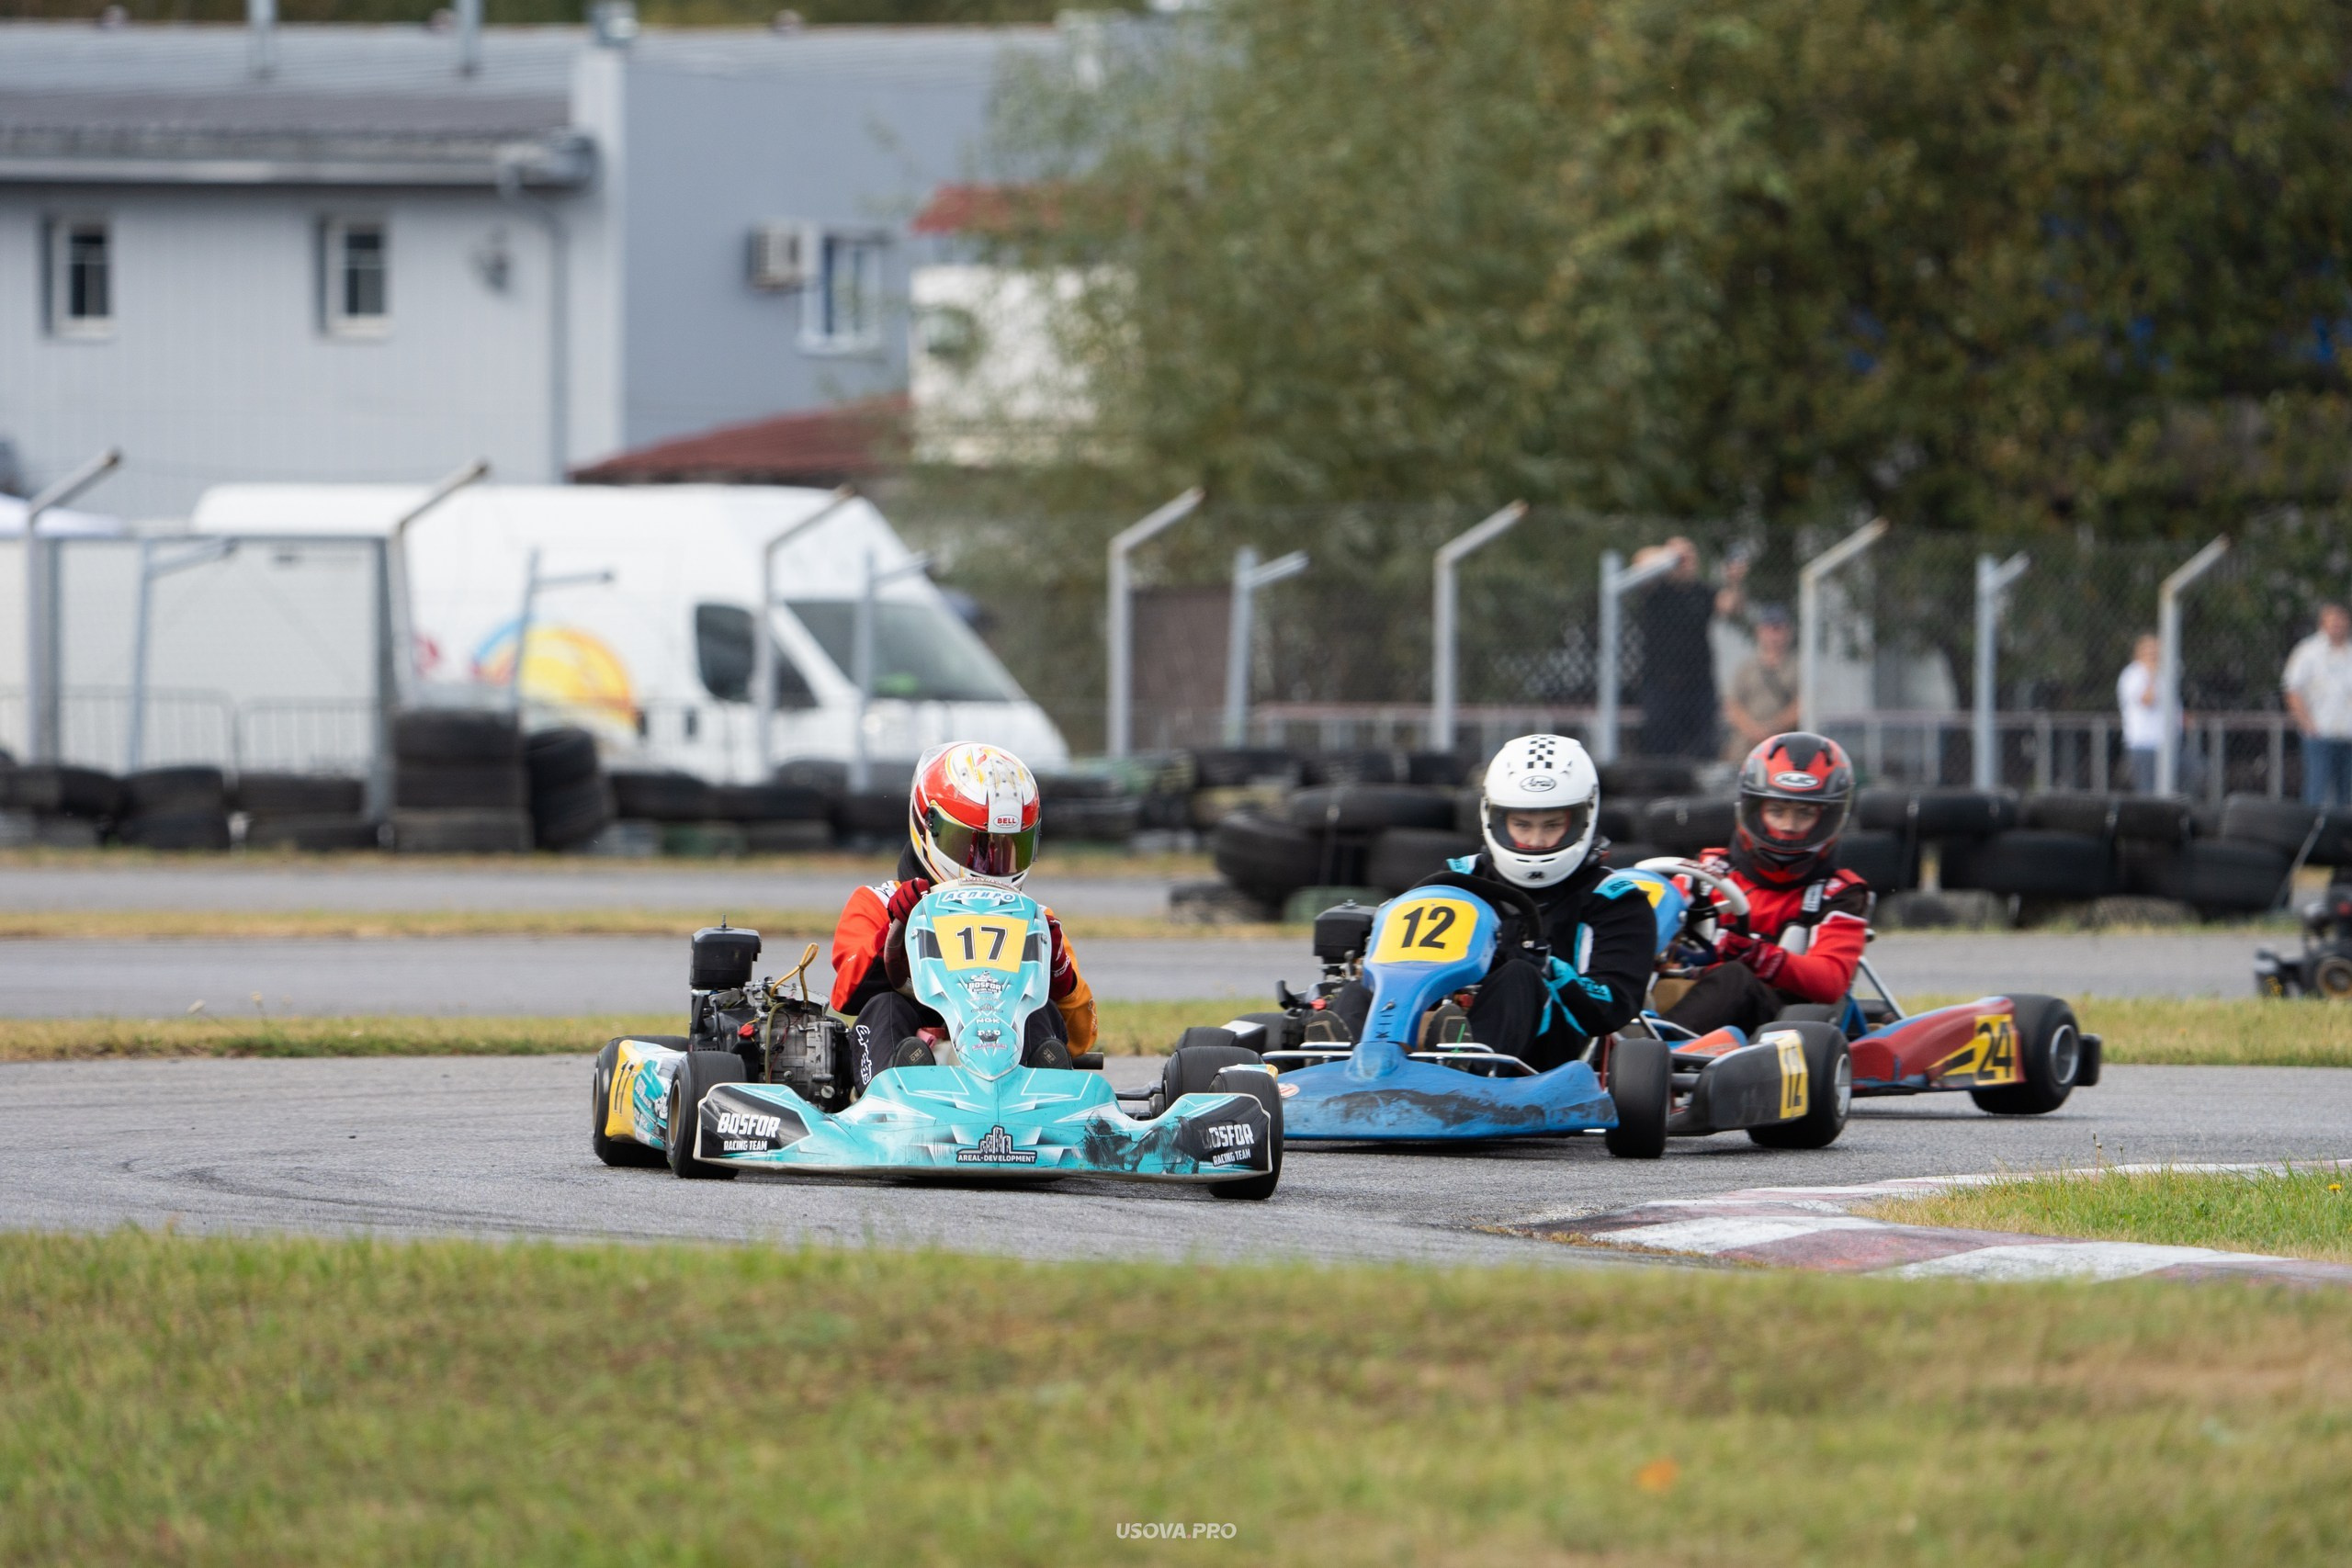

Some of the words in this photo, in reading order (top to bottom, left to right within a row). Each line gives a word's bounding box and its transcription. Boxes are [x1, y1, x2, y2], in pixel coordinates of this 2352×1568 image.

[944, 888, 1015, 902] АСПИРО
[1401, 906, 1456, 950] 12
[956, 926, 1008, 962] 17
[1977, 1021, 2012, 1080] 24
[717, 1112, 781, 1138] BOSFOR
[723, 1140, 749, 1151] RACING
[749, 1140, 768, 1151] TEAM
[957, 1154, 1036, 1163] AREAL-DEVELOPMENT
[1212, 1152, 1236, 1166] RACING
[1235, 1148, 1251, 1161] TEAM
